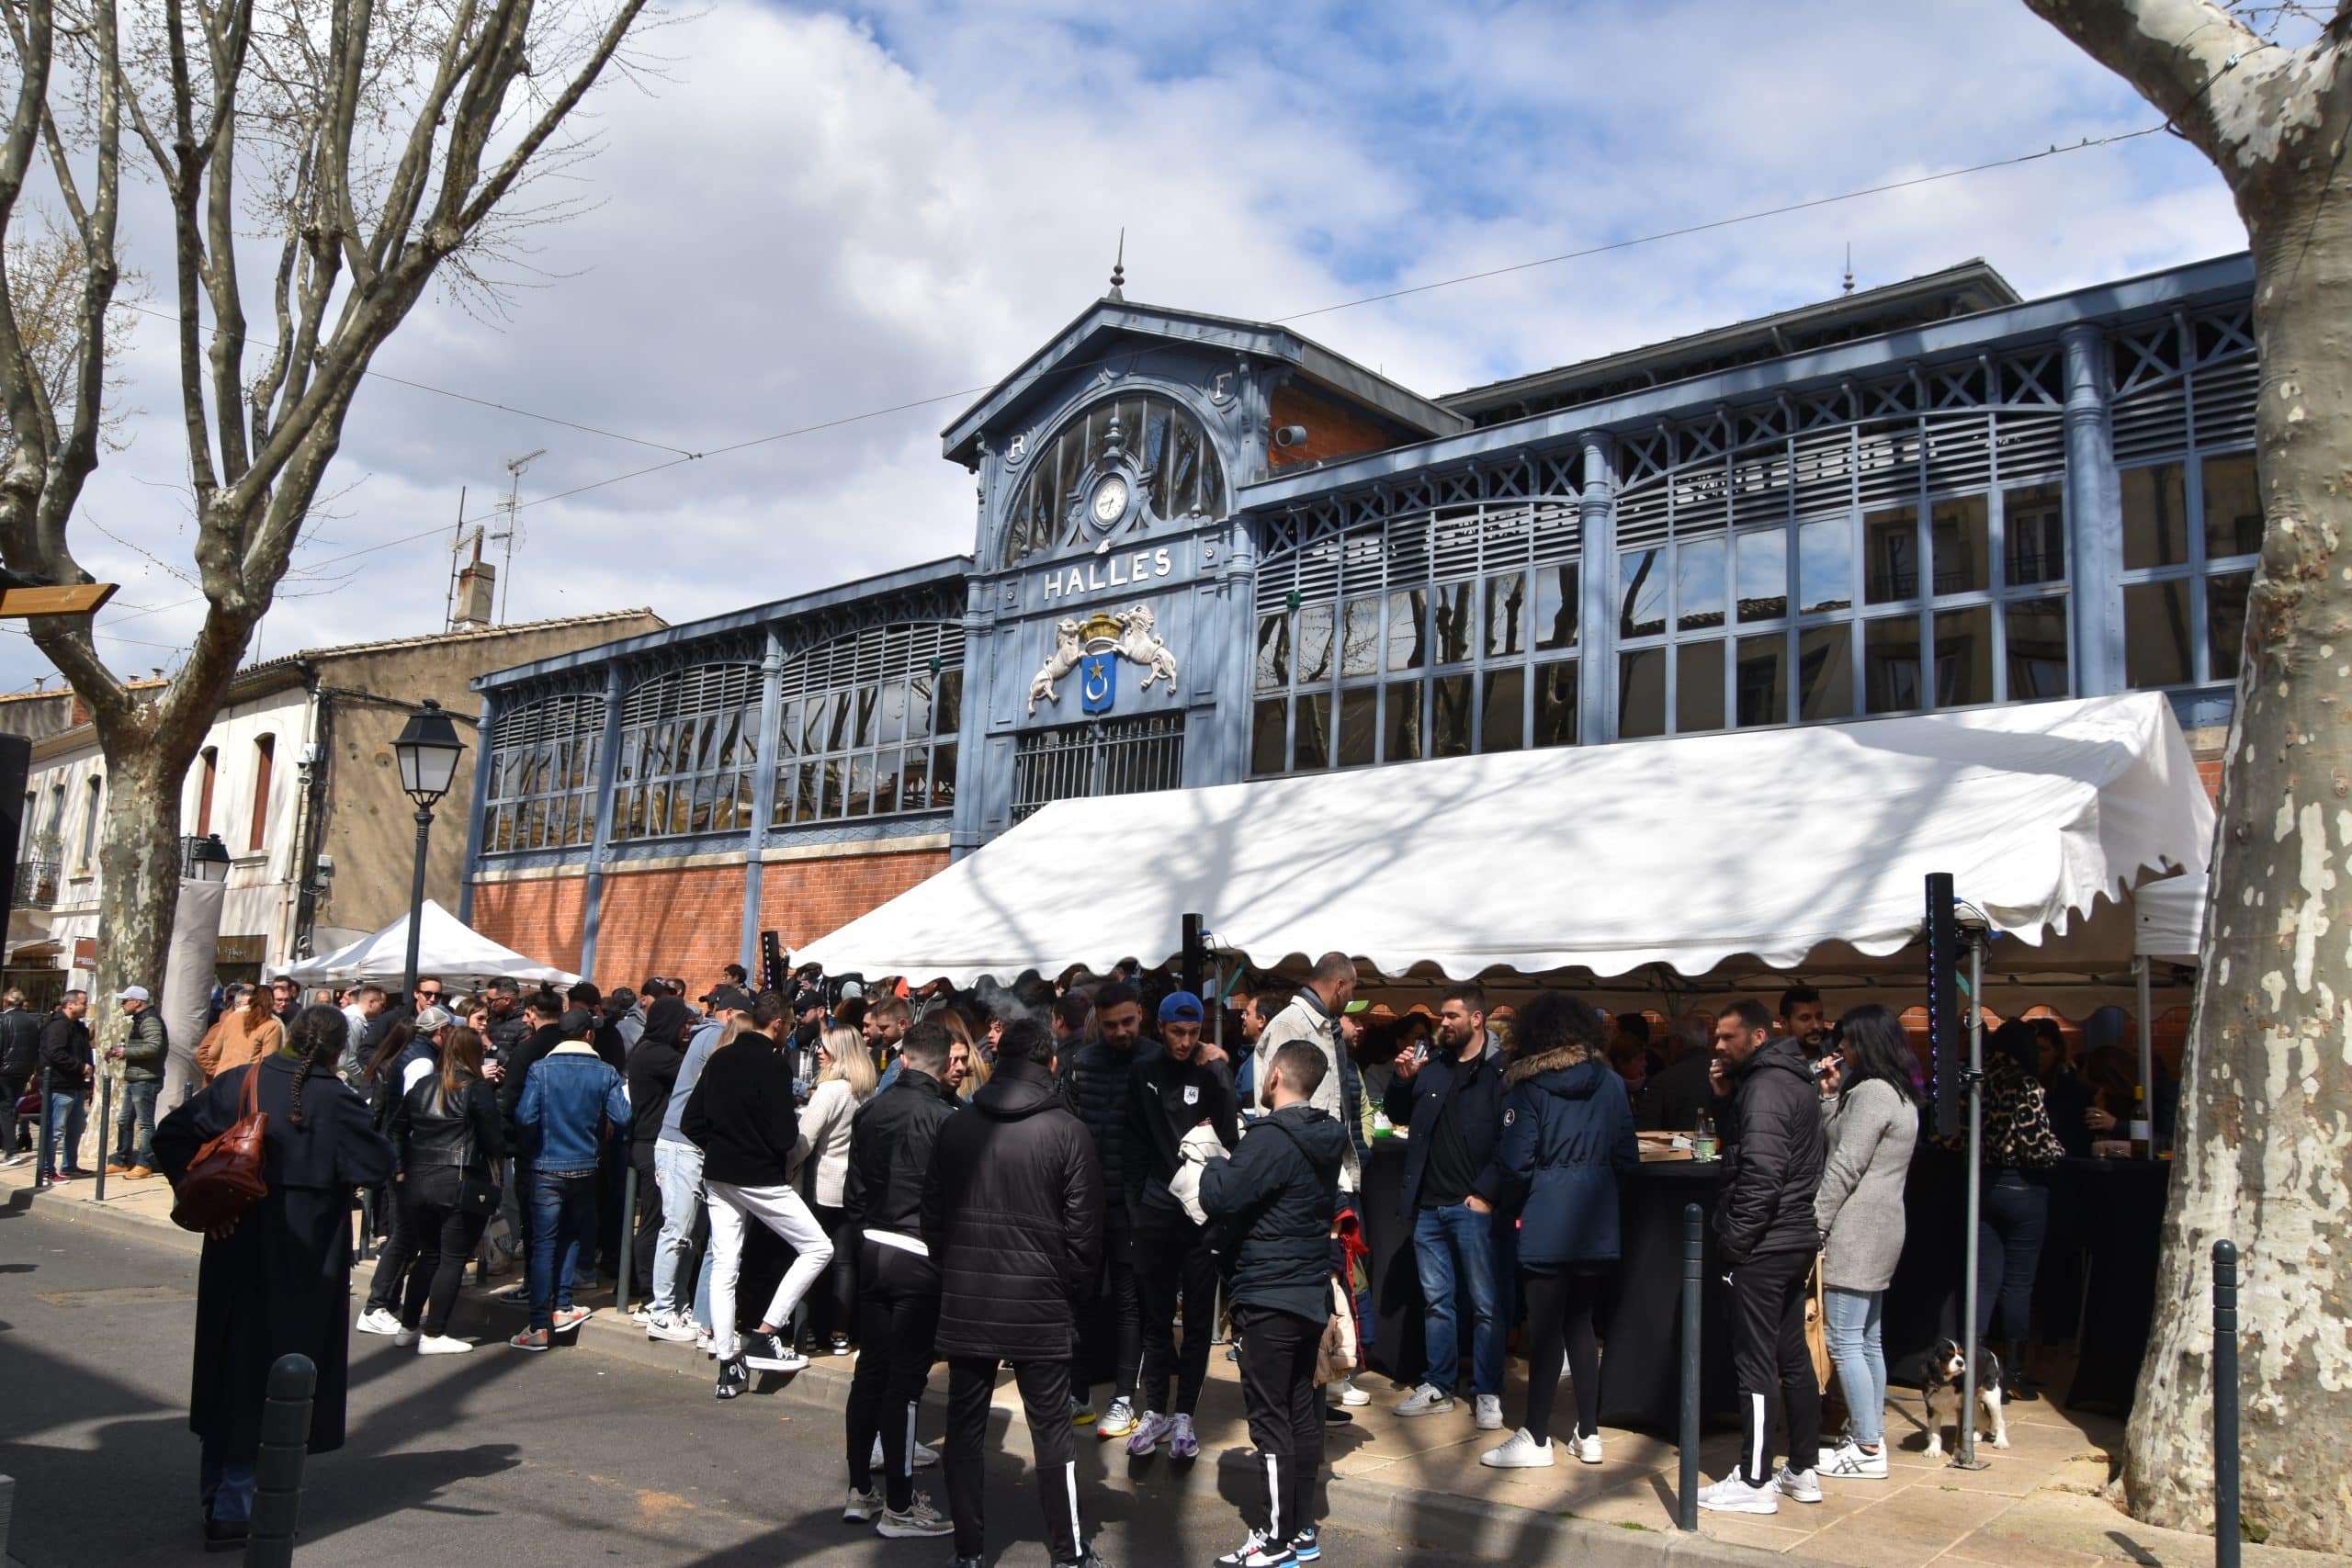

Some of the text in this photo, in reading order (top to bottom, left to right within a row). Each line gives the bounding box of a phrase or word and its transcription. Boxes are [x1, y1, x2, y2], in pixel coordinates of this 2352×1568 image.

[1215, 372, 1233, 399] F
[1010, 434, 1025, 458] R
[1044, 548, 1171, 600] HALLES
